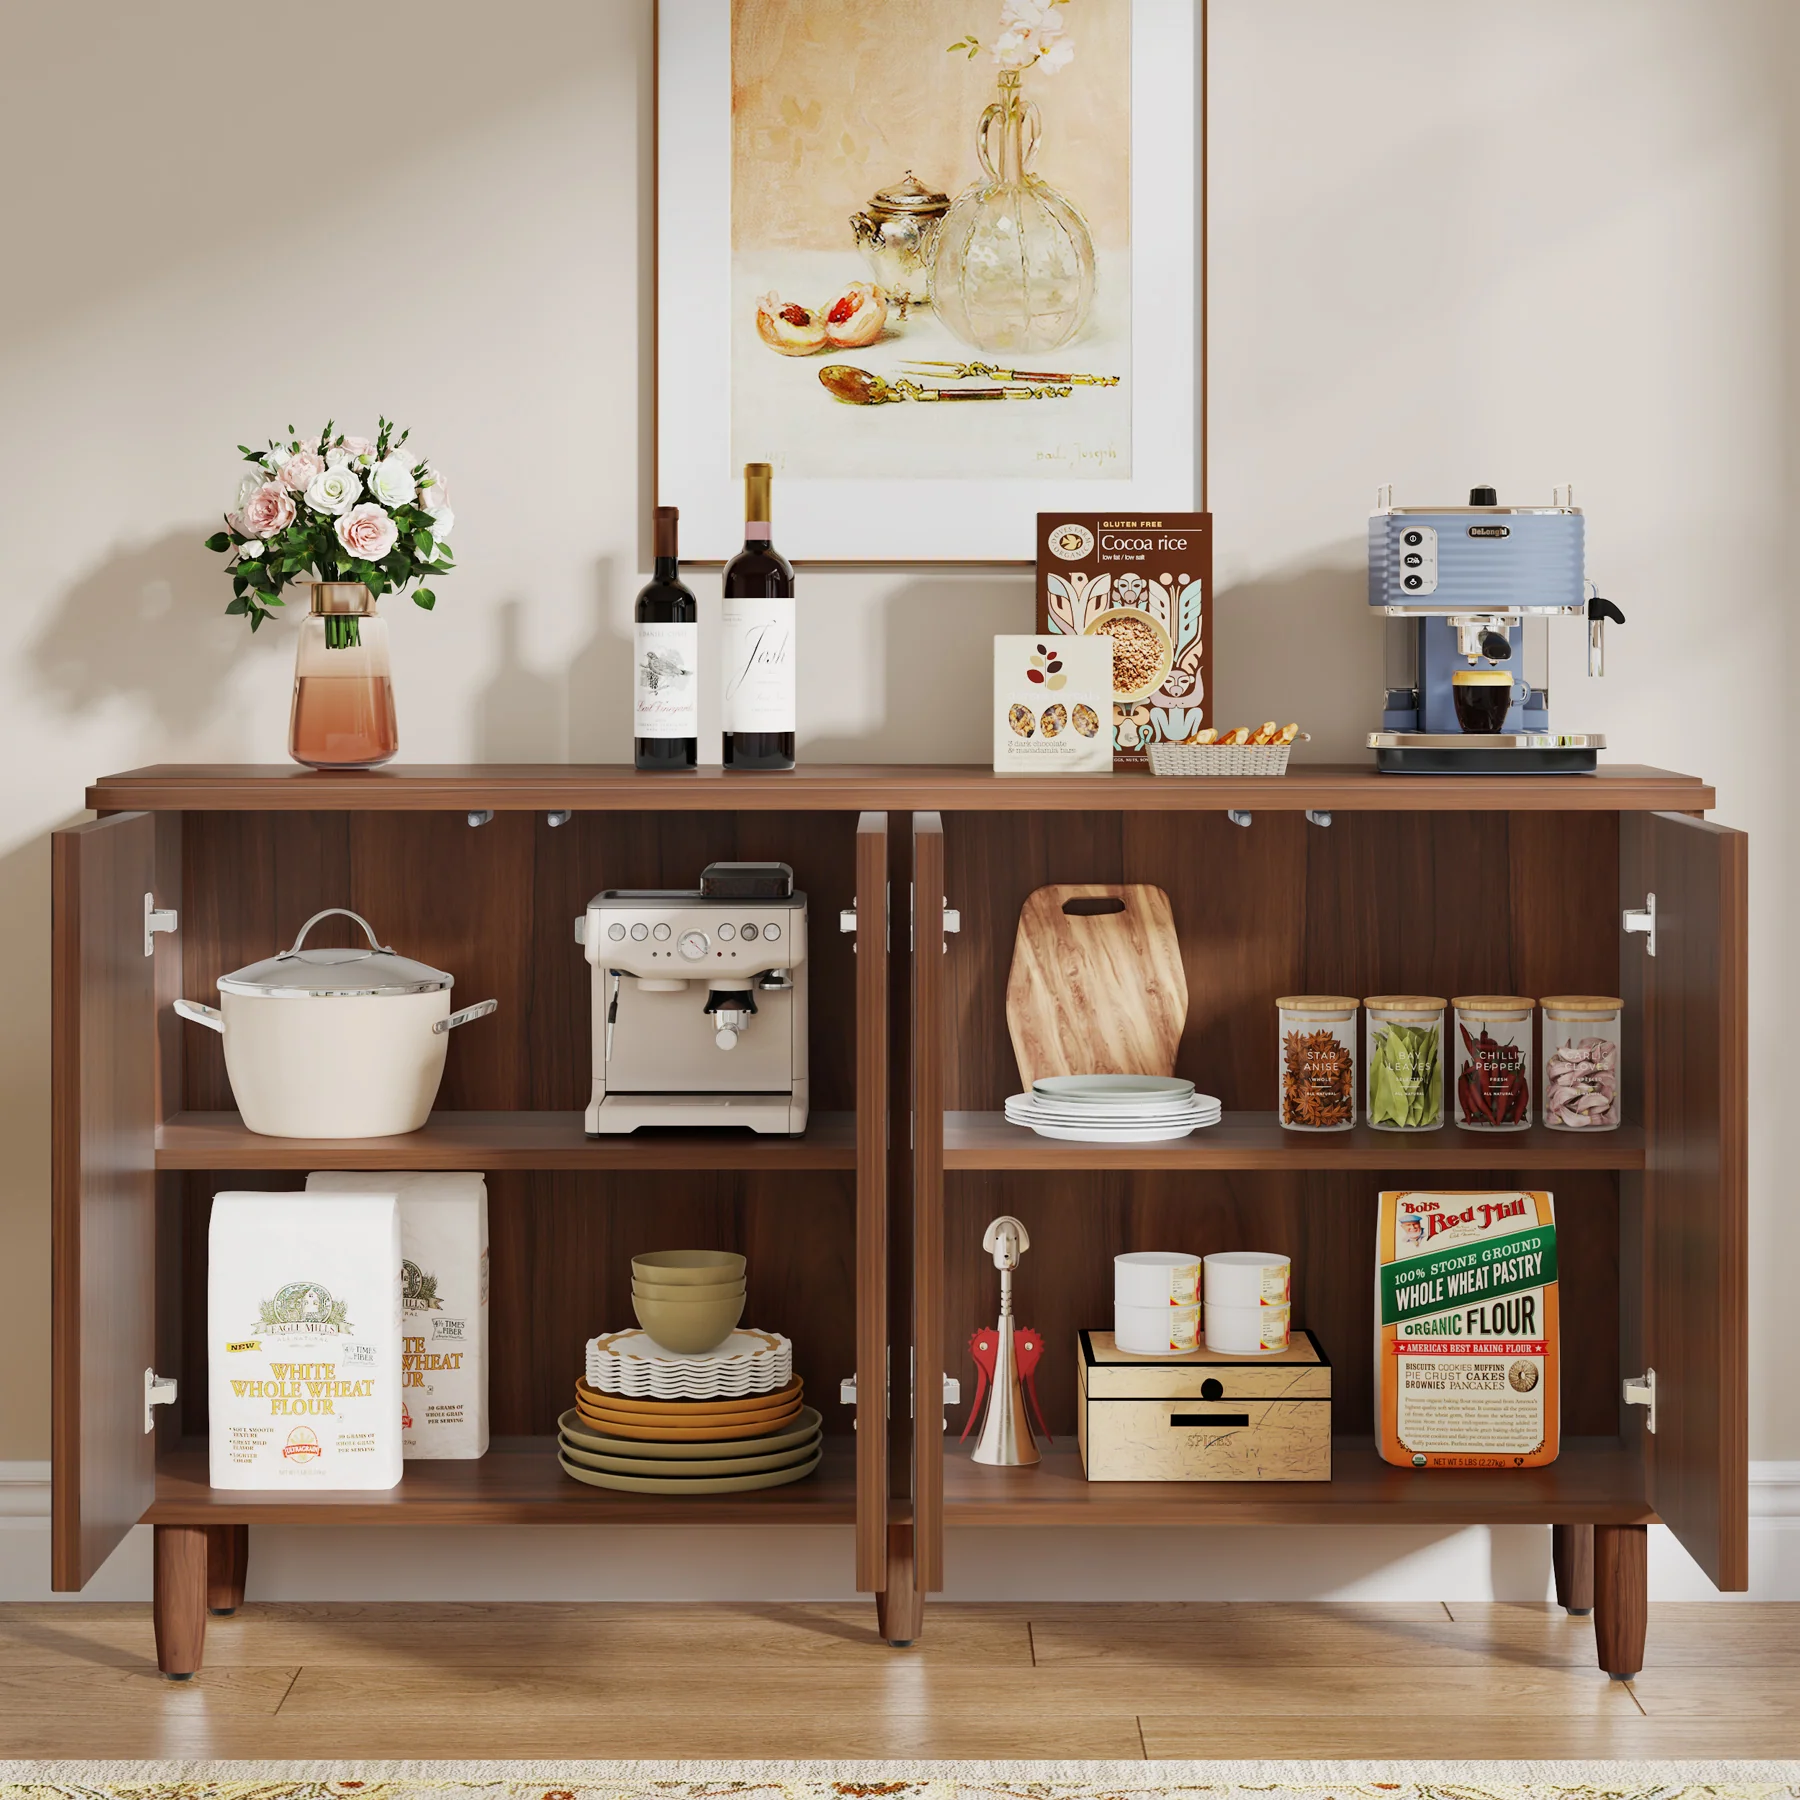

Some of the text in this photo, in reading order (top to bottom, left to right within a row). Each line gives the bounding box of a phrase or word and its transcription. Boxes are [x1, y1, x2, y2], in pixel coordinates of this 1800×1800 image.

[1471, 528, 1507, 537] DeLonghi
[1102, 534, 1188, 551] Cocoa rice
[1307, 1051, 1336, 1060] STAR
[1398, 1051, 1421, 1060] BAY
[1480, 1051, 1517, 1060] CHILLI
[1567, 1051, 1608, 1060] GARLIC
[1303, 1062, 1339, 1071] ANISE
[1388, 1062, 1431, 1071] LEAVES
[1475, 1062, 1521, 1071] PEPPER
[1564, 1062, 1609, 1071] CLOVES
[1401, 1202, 1440, 1214] Bob's
[1426, 1198, 1526, 1241] Red Mill
[1394, 1238, 1542, 1286] 100% STONE GROUND
[1395, 1251, 1543, 1312] WHOLE WHEAT PASTRY
[403, 1298, 425, 1309] ILLS
[1404, 1295, 1537, 1336] ORGANIC FLOUR
[272, 1324, 335, 1334] EAGLE MILLS
[445, 1321, 465, 1329] TIMES
[443, 1327, 462, 1336] FIBER
[230, 1343, 255, 1351] NEW
[1406, 1344, 1532, 1353] AMERICA'S BEST BAKING FLOUR
[402, 1353, 464, 1371] WHEAT
[269, 1363, 336, 1380] WHITE
[1406, 1363, 1435, 1371] BISCUITS
[1474, 1364, 1505, 1372] MUFFINS
[1406, 1372, 1505, 1381] PIE CRUST CAKES
[230, 1379, 375, 1398] WHOLE WHEAT
[1406, 1381, 1505, 1390] BROWNIES PANCAKES
[270, 1399, 336, 1416] FLOUR
[1434, 1458, 1506, 1467] NET WT 5 LBS (2.27kg)
